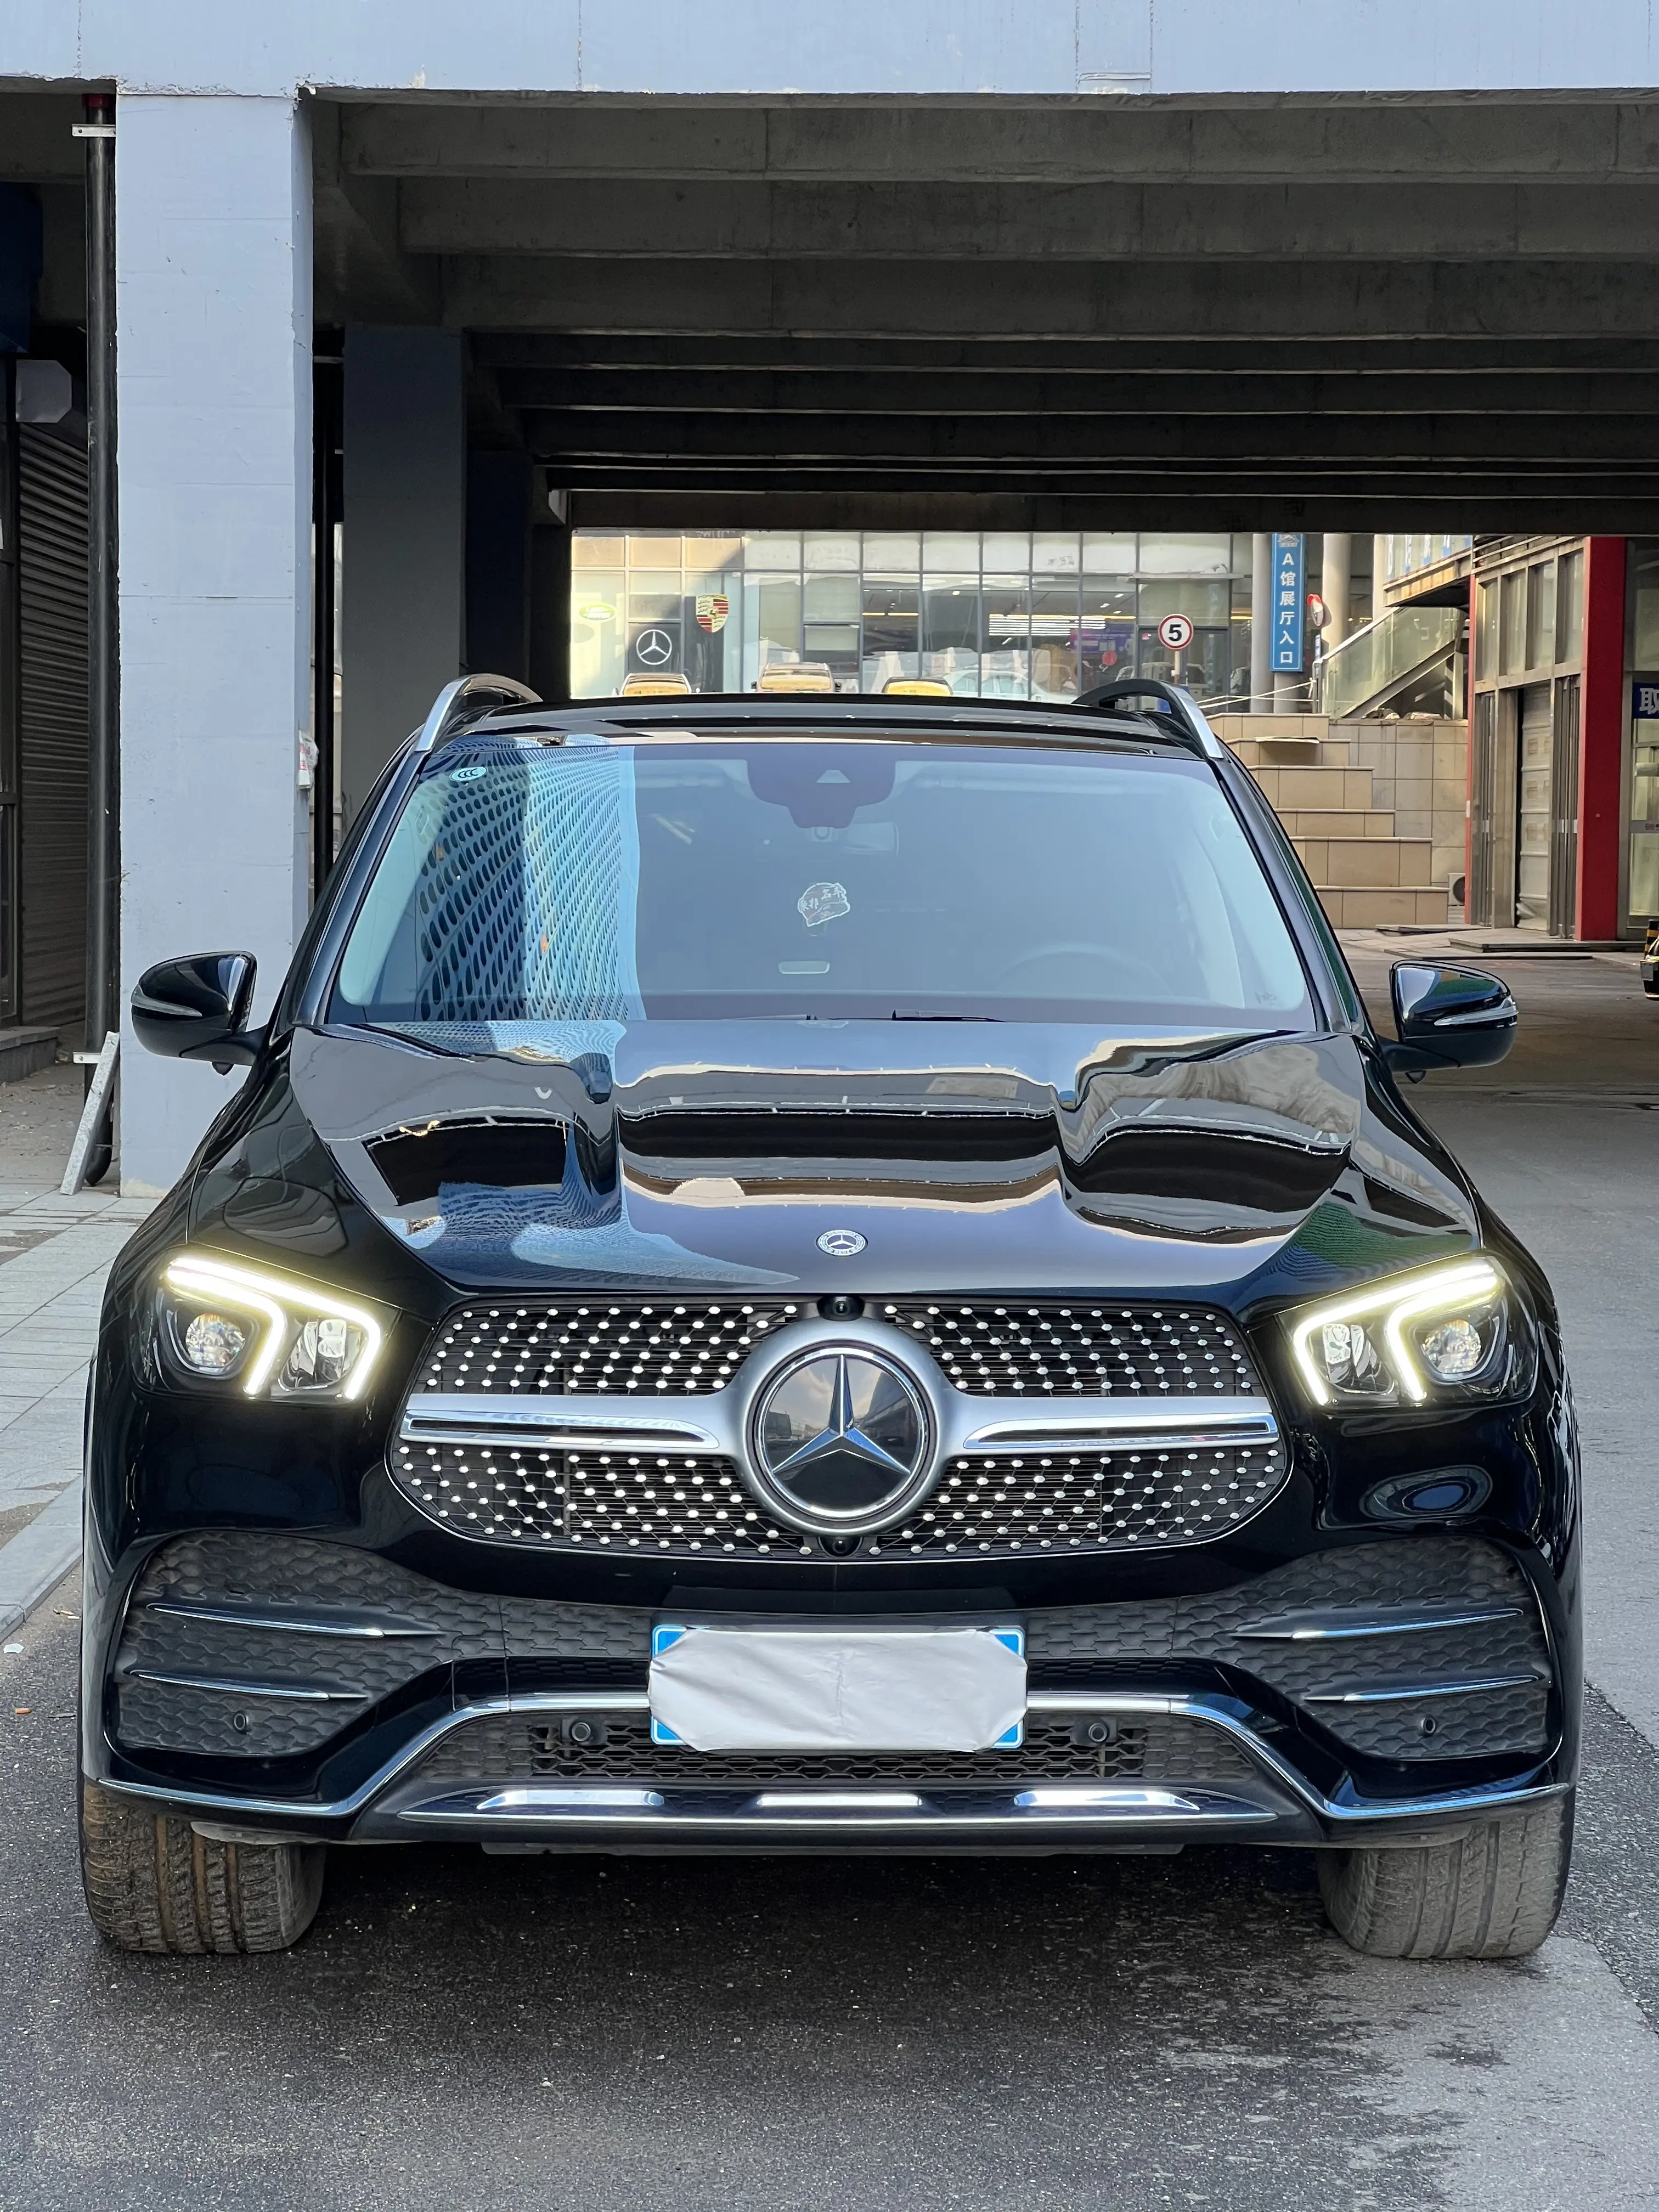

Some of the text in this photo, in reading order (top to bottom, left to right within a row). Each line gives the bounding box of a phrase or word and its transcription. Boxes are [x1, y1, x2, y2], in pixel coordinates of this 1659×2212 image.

[1279, 553, 1296, 663] A馆展厅入口
[1167, 624, 1182, 642] 5
[458, 768, 478, 778] CCC
